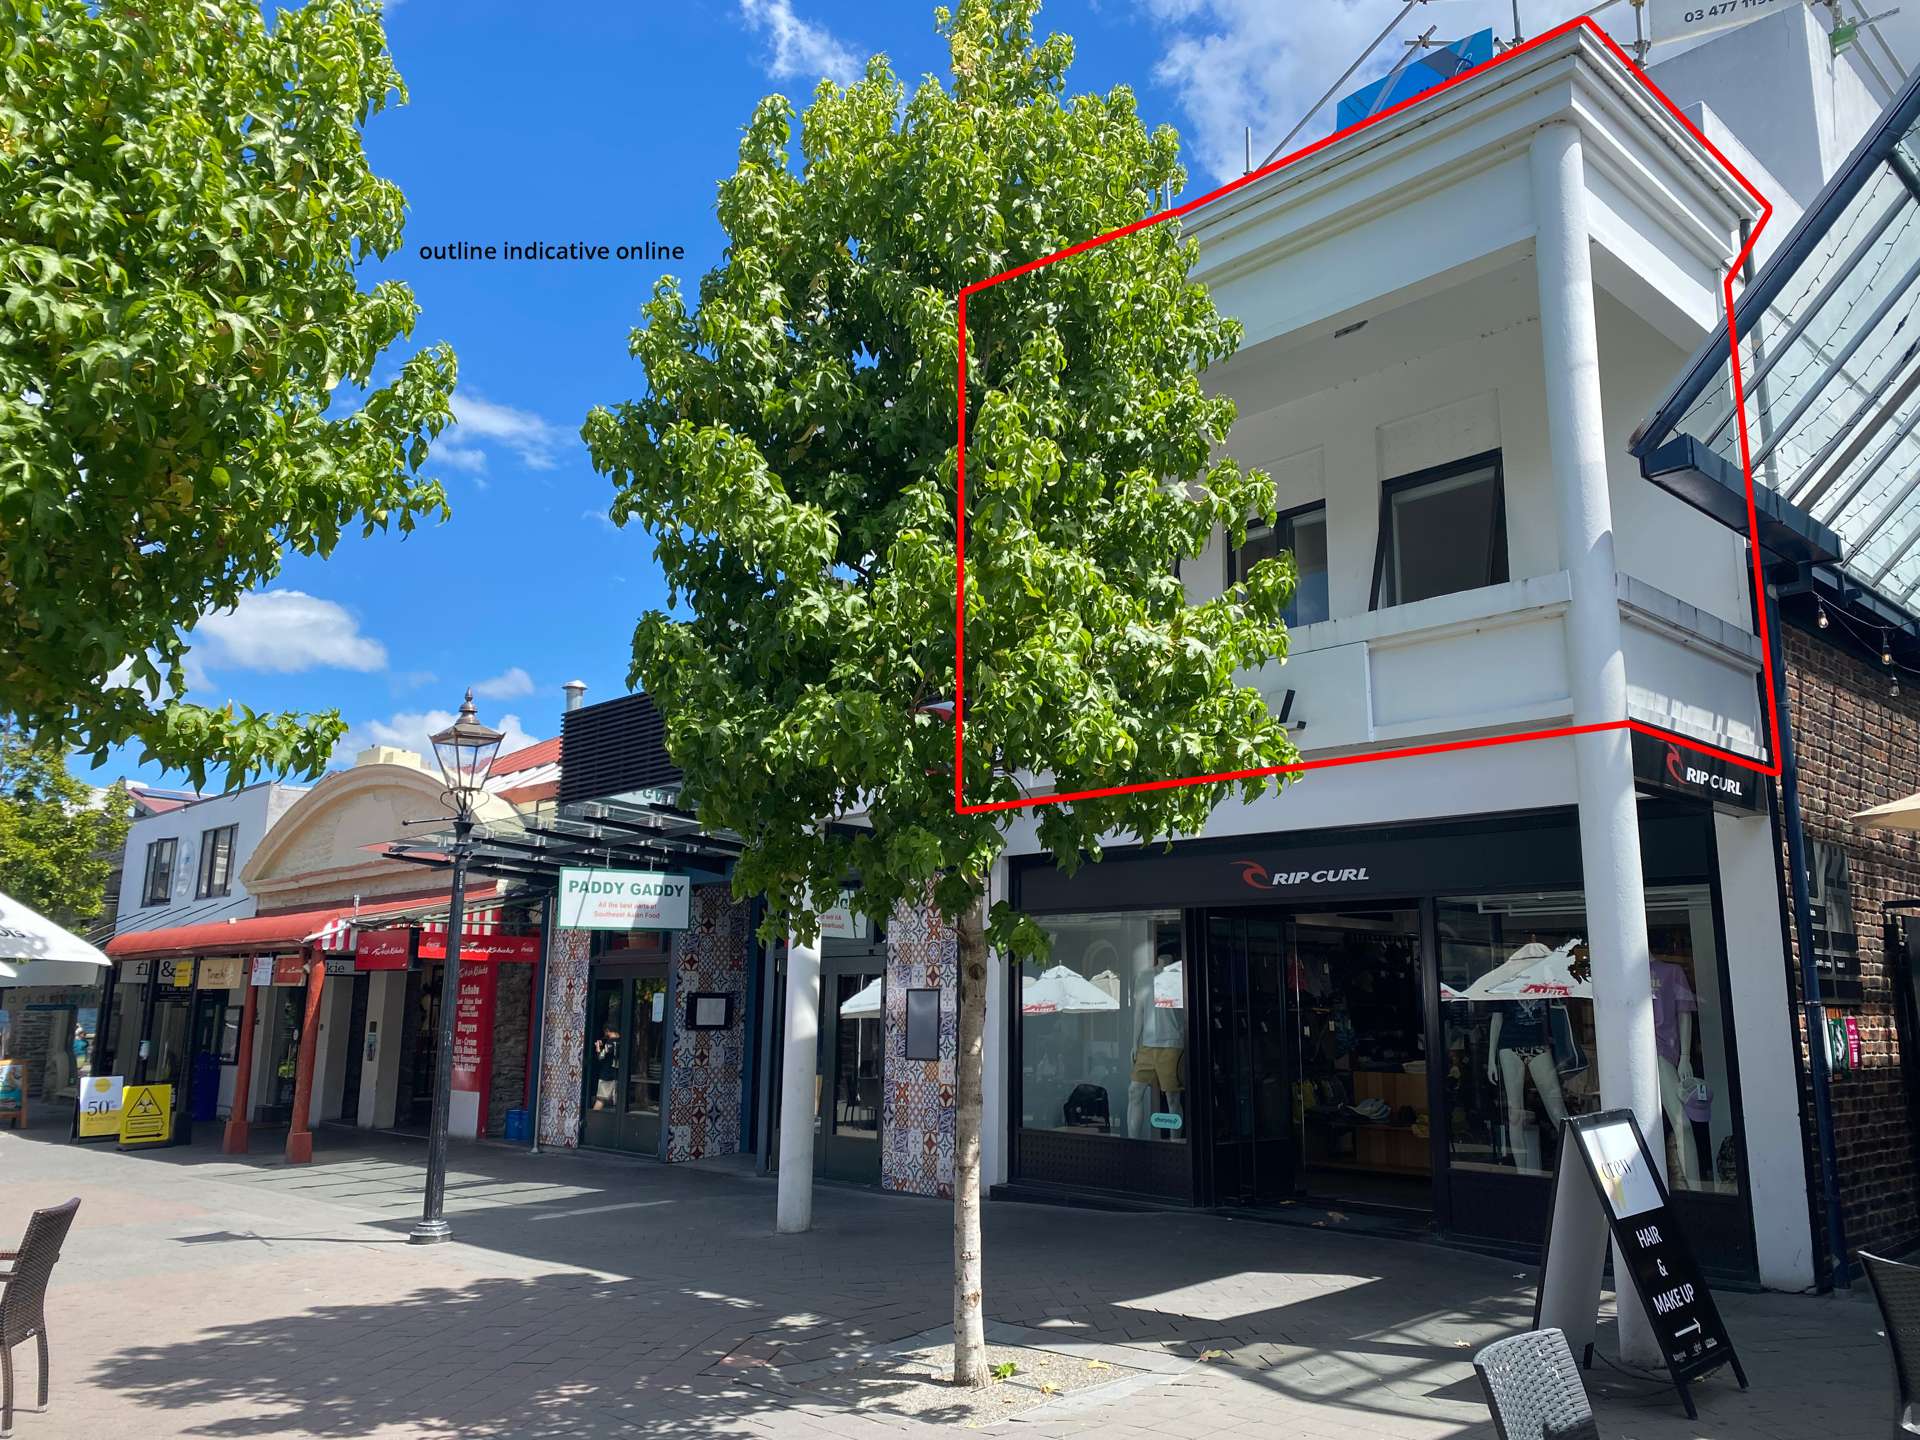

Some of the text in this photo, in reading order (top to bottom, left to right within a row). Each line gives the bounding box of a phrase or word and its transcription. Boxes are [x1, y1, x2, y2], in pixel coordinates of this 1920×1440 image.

[1684, 9, 1704, 23] 03
[1708, 0, 1738, 17] 477
[1685, 767, 1743, 796] RIP CURL
[1272, 867, 1369, 885] RIP CURL
[568, 880, 685, 897] PADDY GADDY
[645, 912, 661, 920] Food
[1635, 1225, 1663, 1249] HAIR
[1656, 1258, 1669, 1277] &
[1652, 1282, 1695, 1316] MAKE UP
